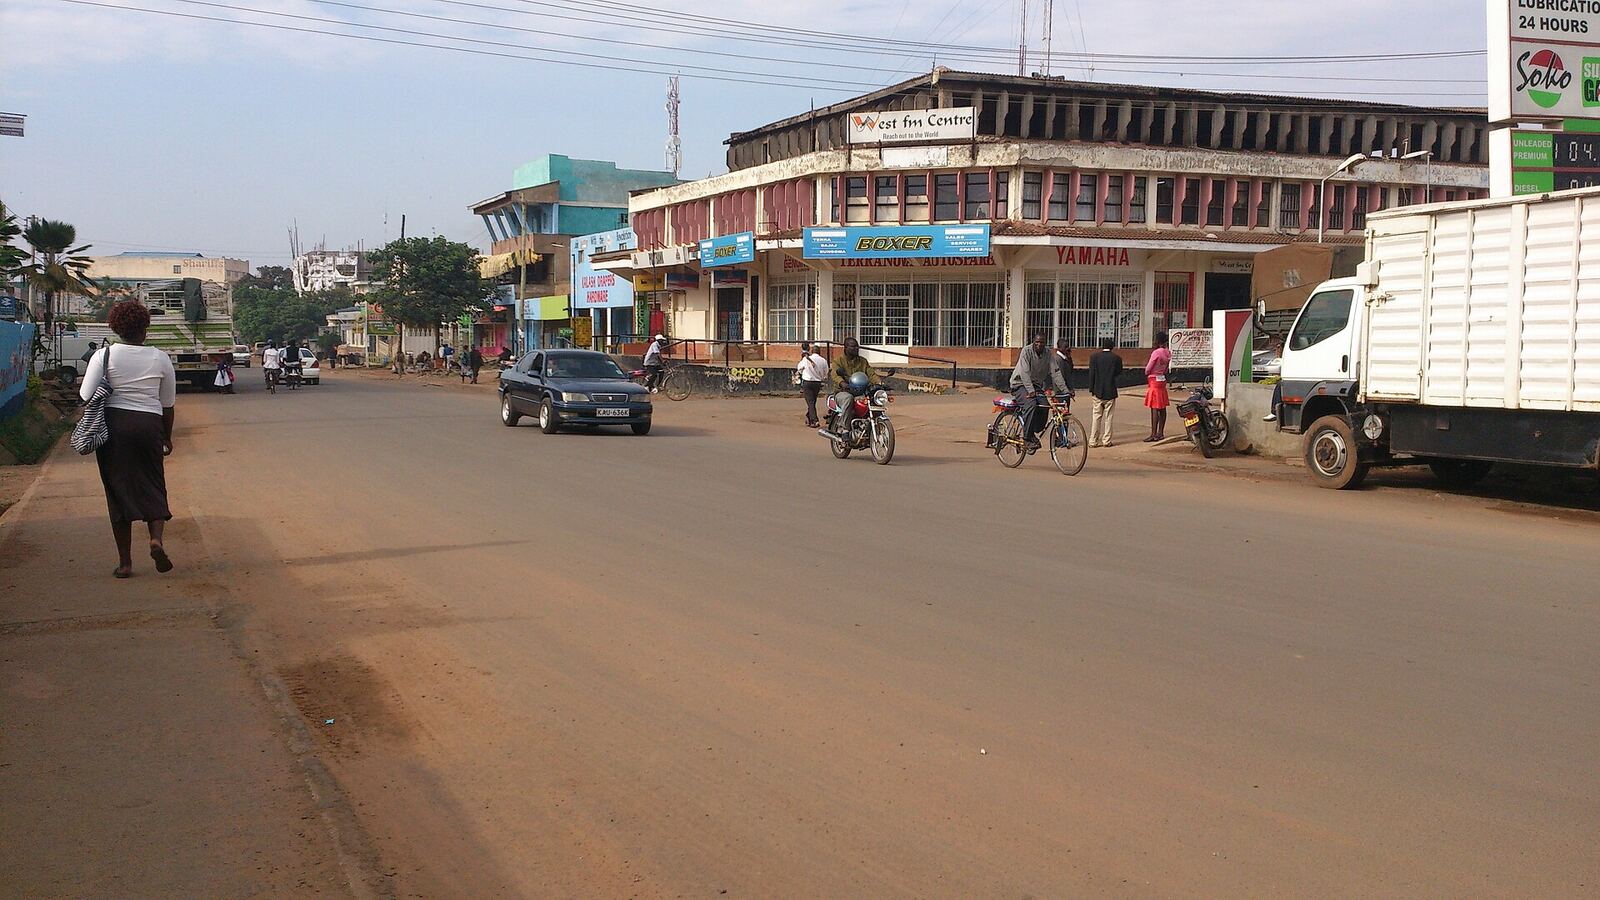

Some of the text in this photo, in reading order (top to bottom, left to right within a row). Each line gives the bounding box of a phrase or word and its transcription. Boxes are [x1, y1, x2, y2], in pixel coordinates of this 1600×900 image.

[1519, 15, 1588, 33] 24 HOURS
[1516, 51, 1572, 91] Soko
[851, 114, 972, 132] West fm Centre
[1513, 140, 1552, 148] UNLEADED
[1513, 152, 1548, 160] PREMIUM
[1514, 184, 1540, 192] DIESEL
[715, 245, 737, 257] BOXER
[856, 236, 933, 251] BOXER
[1056, 246, 1129, 265] YAMAHA
